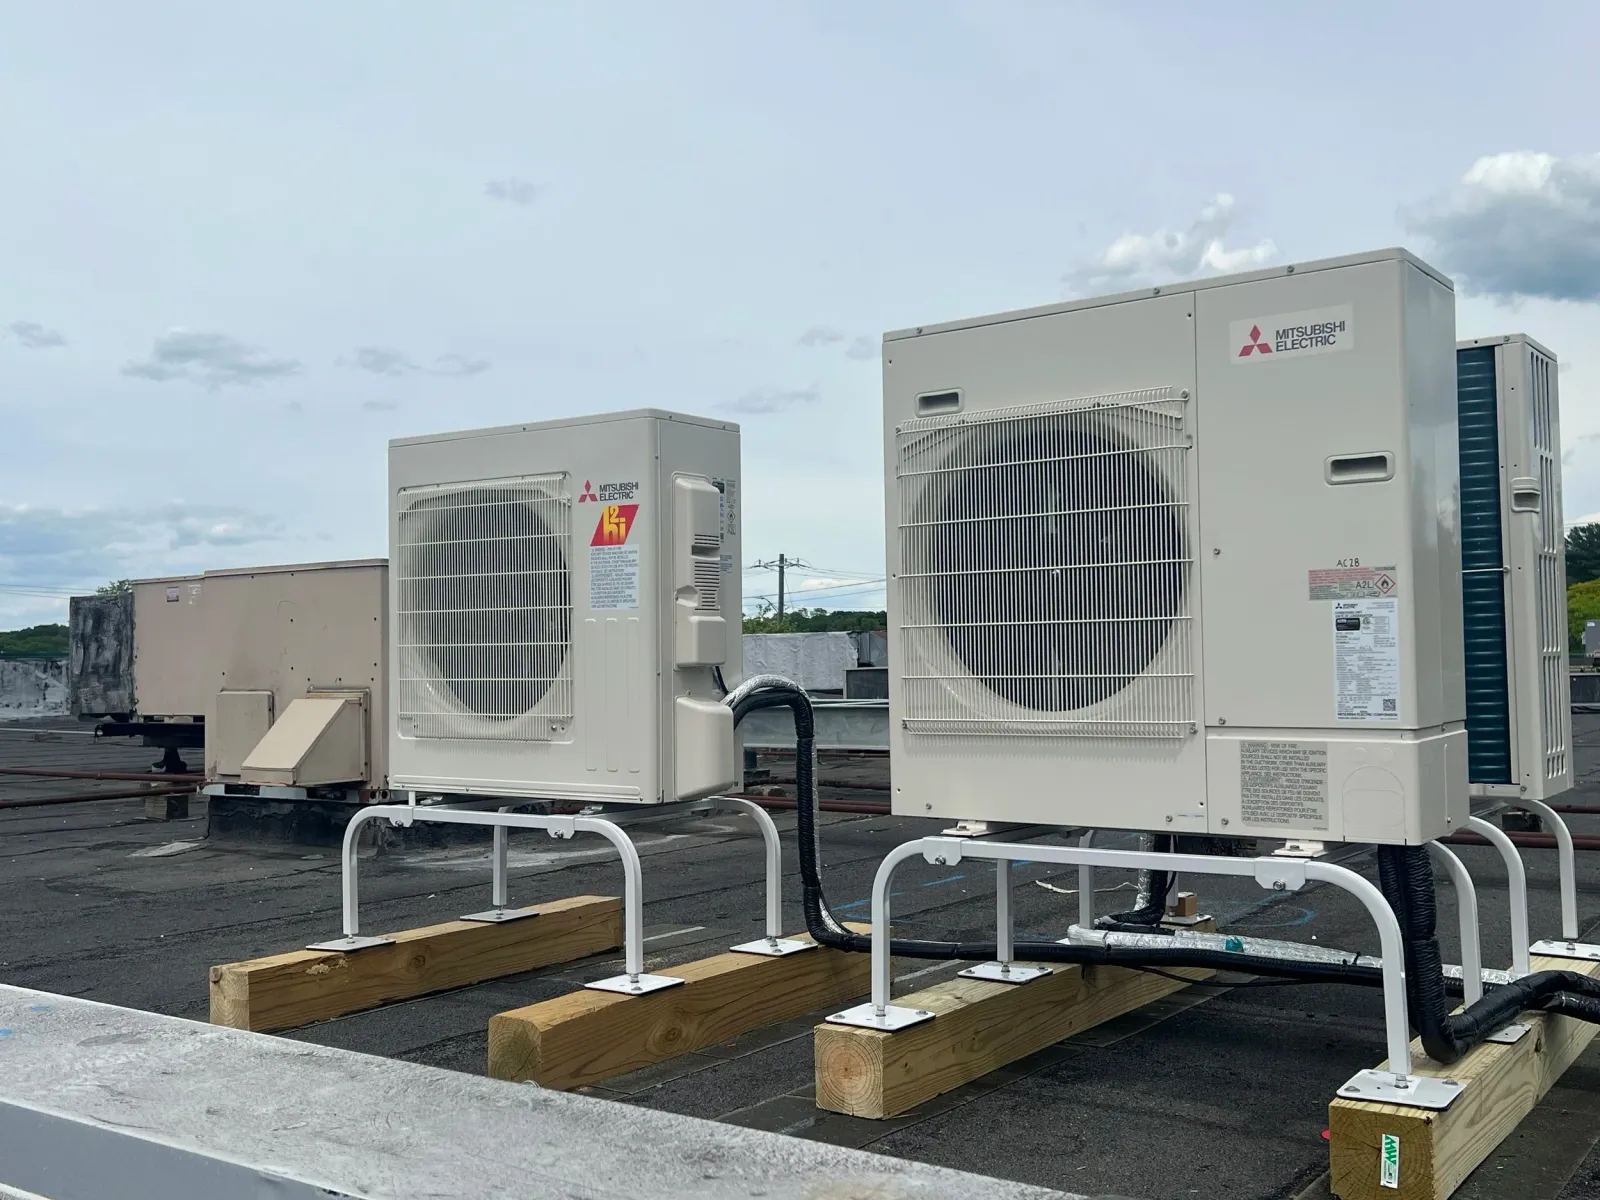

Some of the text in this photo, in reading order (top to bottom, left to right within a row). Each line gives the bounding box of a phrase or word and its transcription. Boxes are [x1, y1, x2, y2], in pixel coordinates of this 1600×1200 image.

[1276, 320, 1346, 340] MITSUBISHI
[1276, 334, 1336, 352] ELECTRIC
[600, 482, 638, 492] MITSUBISHI
[600, 492, 634, 502] ELECTRIC
[1356, 580, 1374, 589] A2L
